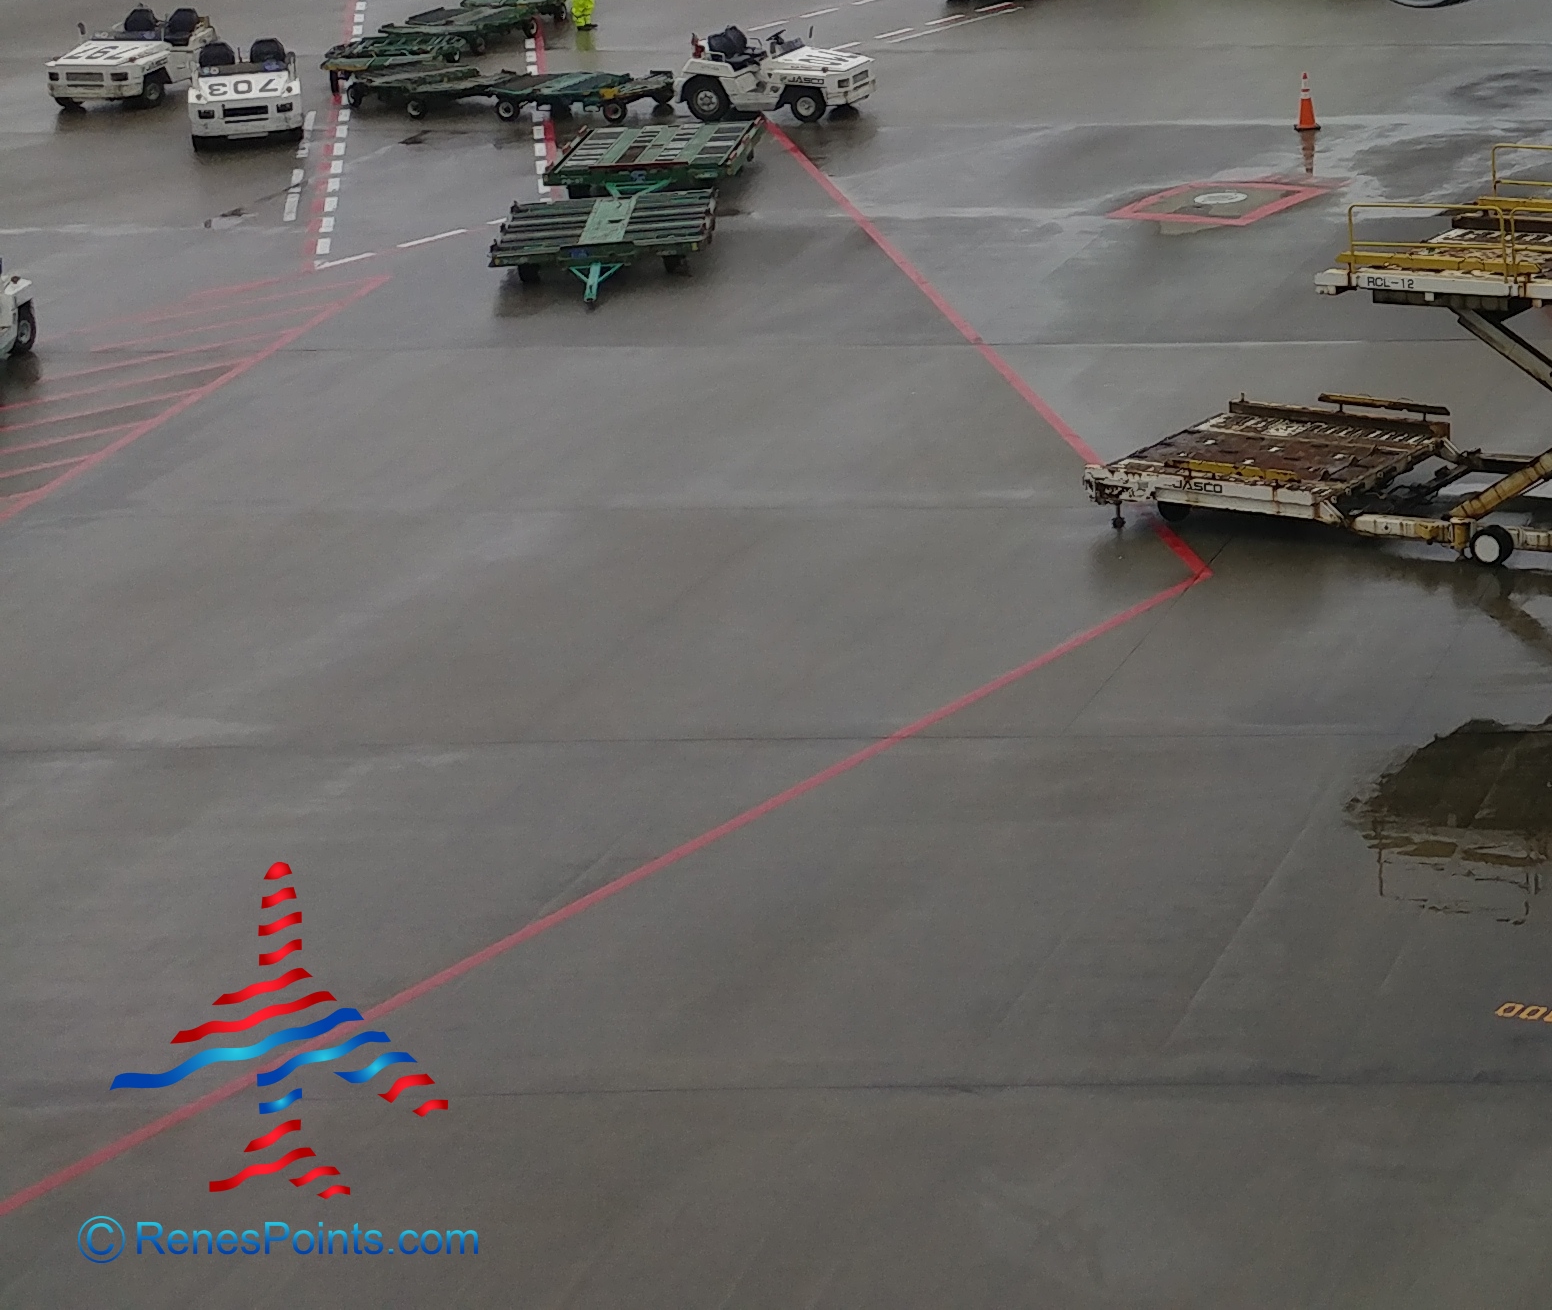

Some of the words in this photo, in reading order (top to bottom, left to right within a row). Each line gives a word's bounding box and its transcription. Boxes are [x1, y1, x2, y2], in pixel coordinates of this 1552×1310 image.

[64, 45, 139, 60] 797
[207, 77, 279, 97] 703
[788, 76, 825, 86] JASCO
[1366, 276, 1415, 290] RCL-12
[1171, 479, 1223, 494] JASCO
